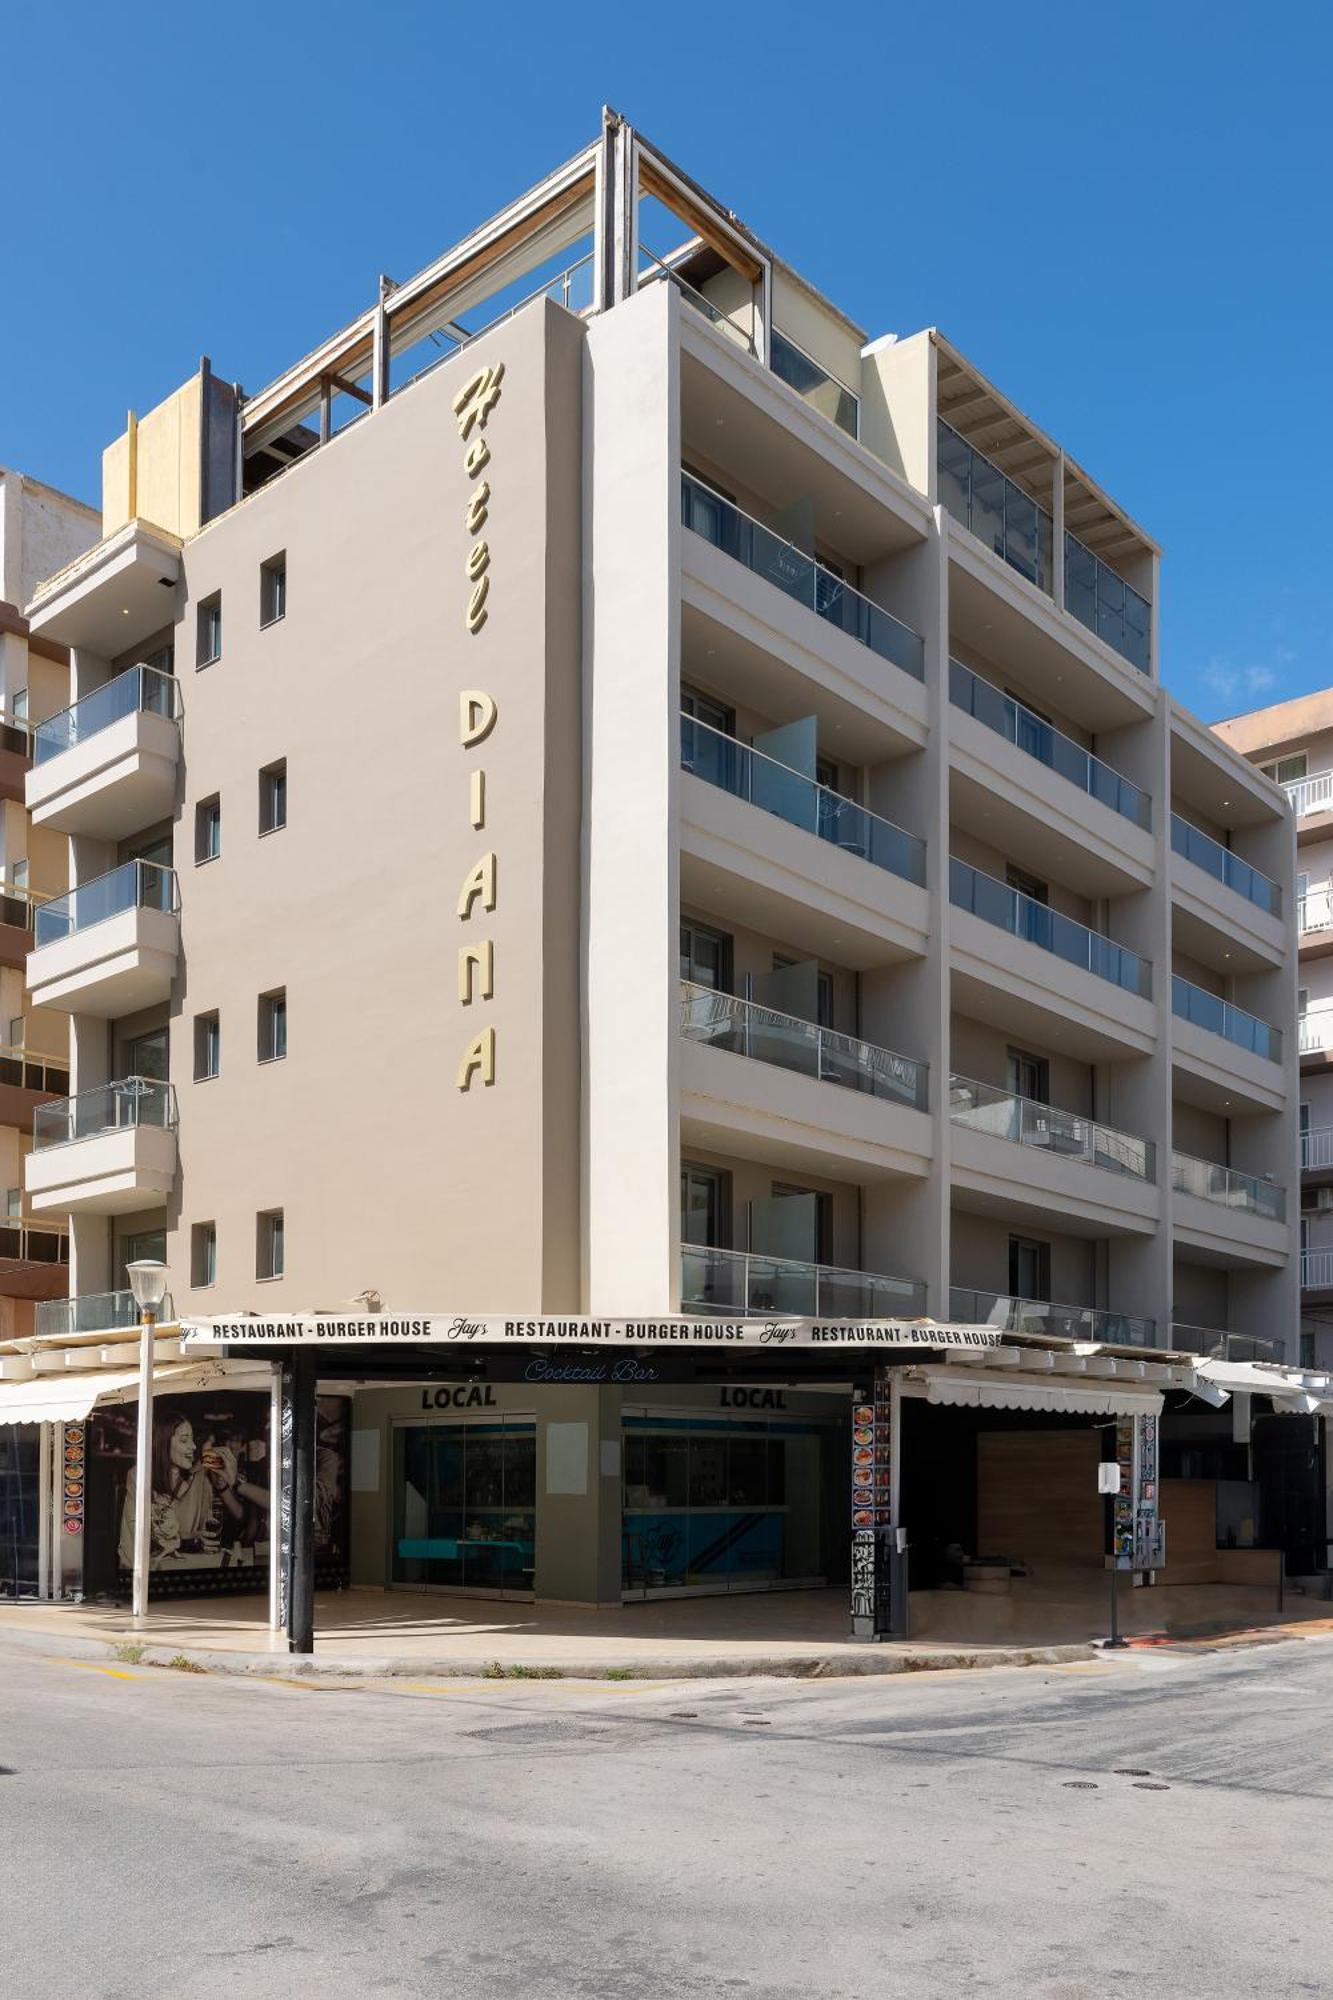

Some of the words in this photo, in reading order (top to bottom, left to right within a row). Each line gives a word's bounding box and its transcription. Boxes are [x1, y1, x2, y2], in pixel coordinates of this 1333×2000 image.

[451, 362, 506, 635] Hotel
[455, 689, 499, 1093] DIANA
[212, 1322, 304, 1338] RESTAURANT
[316, 1321, 376, 1337] BURGER
[380, 1320, 431, 1336] HOUSE
[447, 1318, 488, 1340] Jay's
[505, 1322, 611, 1338] RESTAURANT
[625, 1324, 689, 1339] BURGER
[693, 1324, 744, 1339] HOUSE
[759, 1322, 798, 1343] Jay's
[812, 1326, 901, 1342] RESTAURANT
[911, 1329, 962, 1344] BURGER
[963, 1332, 1001, 1348] HOUSE
[524, 1359, 607, 1381] Cocktail
[611, 1359, 659, 1381] Bar
[422, 1385, 497, 1409] LOCAL
[720, 1386, 787, 1409] LOCAL
